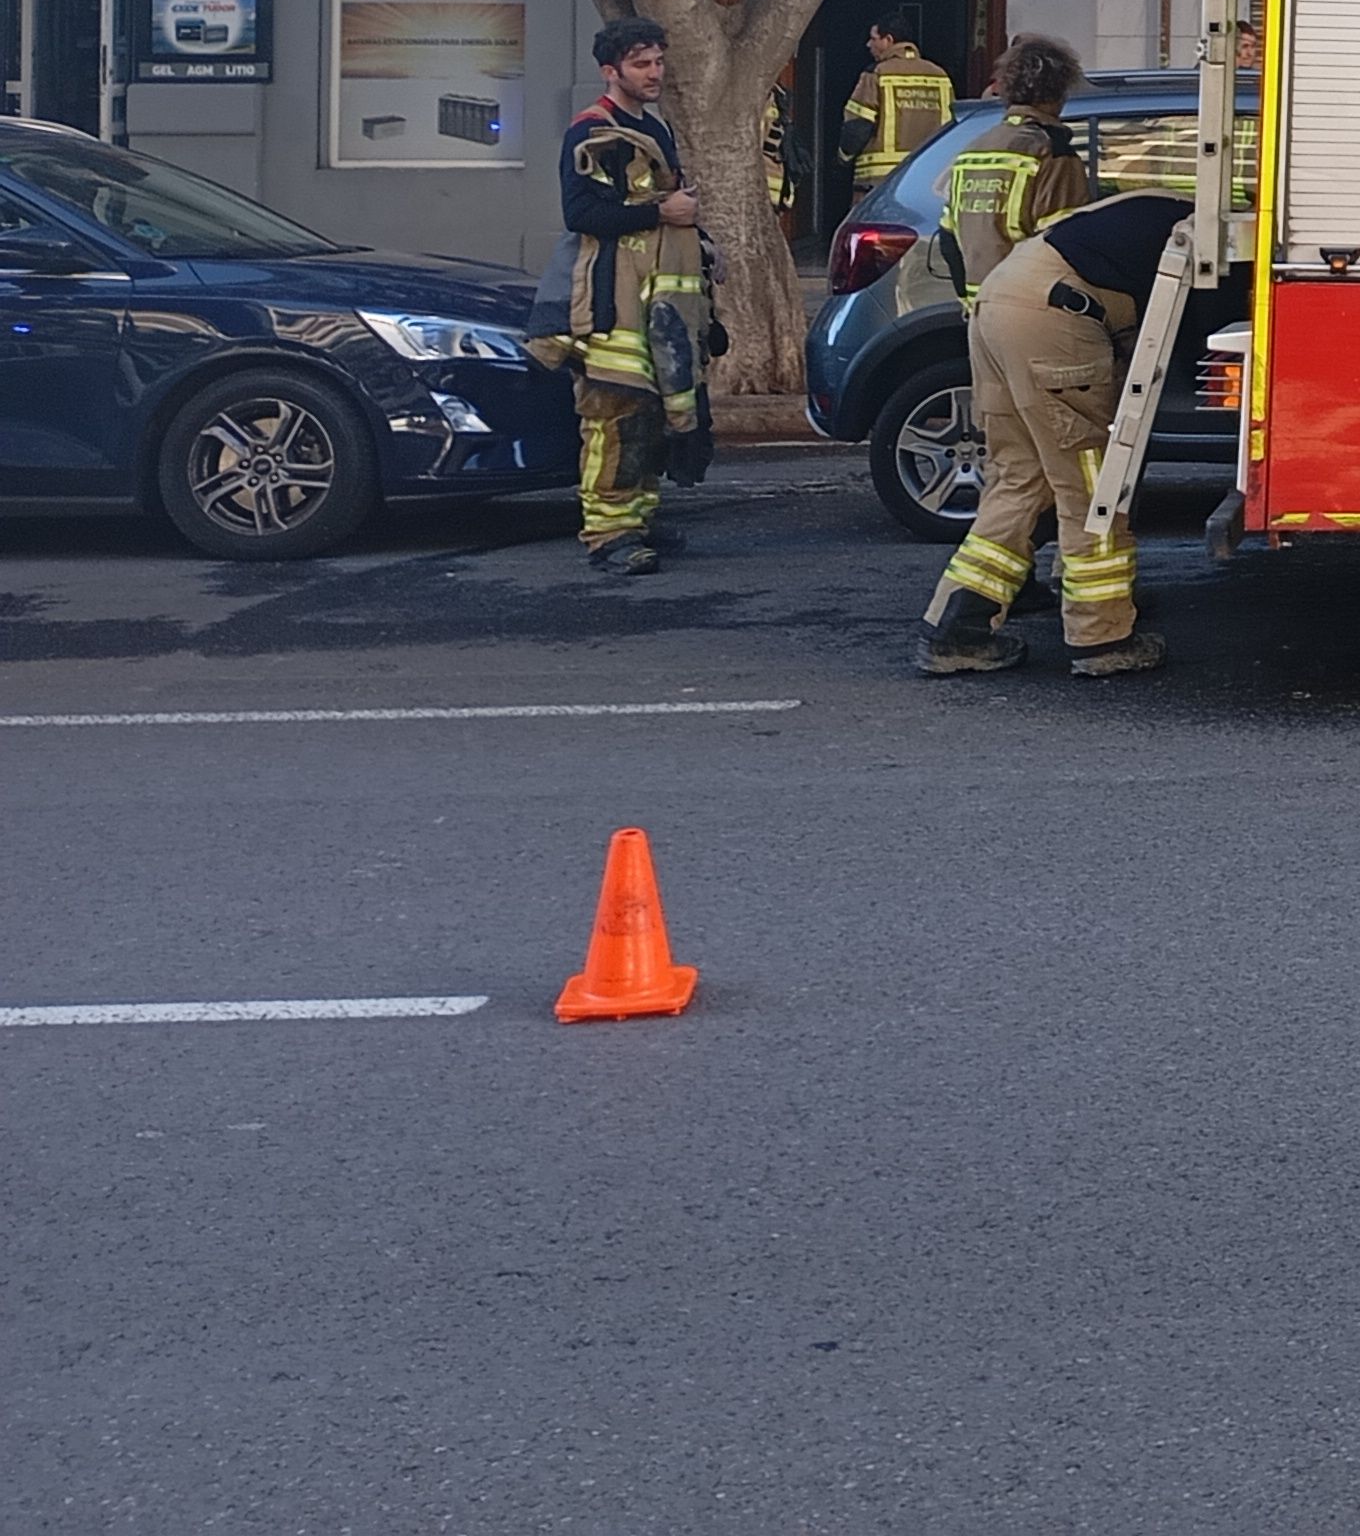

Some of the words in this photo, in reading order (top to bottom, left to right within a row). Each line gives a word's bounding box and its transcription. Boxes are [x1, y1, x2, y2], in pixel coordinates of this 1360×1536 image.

[152, 65, 175, 76] GEL
[187, 66, 214, 76] AGM
[225, 66, 256, 76] LITIO
